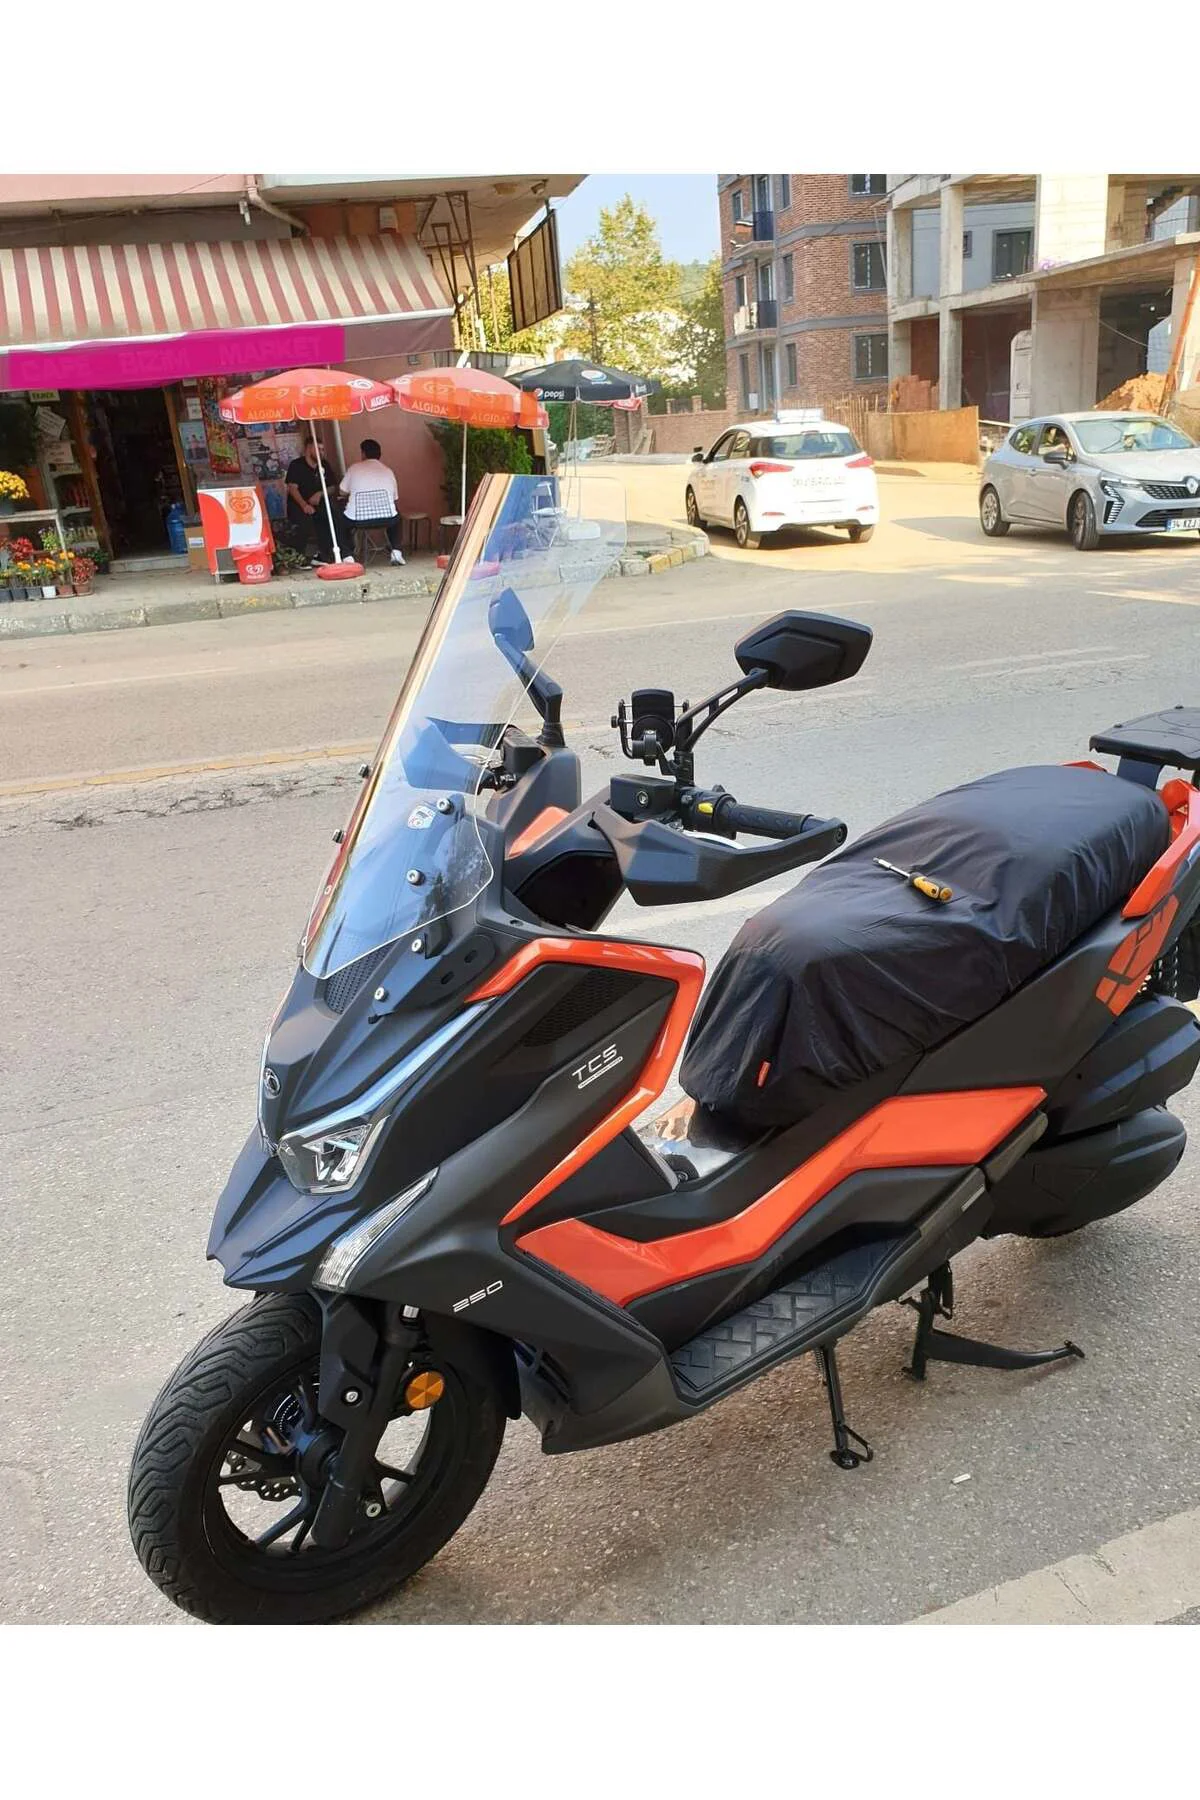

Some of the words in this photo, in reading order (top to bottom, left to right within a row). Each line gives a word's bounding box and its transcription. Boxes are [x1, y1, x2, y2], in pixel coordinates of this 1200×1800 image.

[217, 334, 322, 366] MARKET
[410, 399, 449, 415] ALGIDA
[571, 1043, 618, 1081] TCS
[452, 1279, 503, 1313] 250
